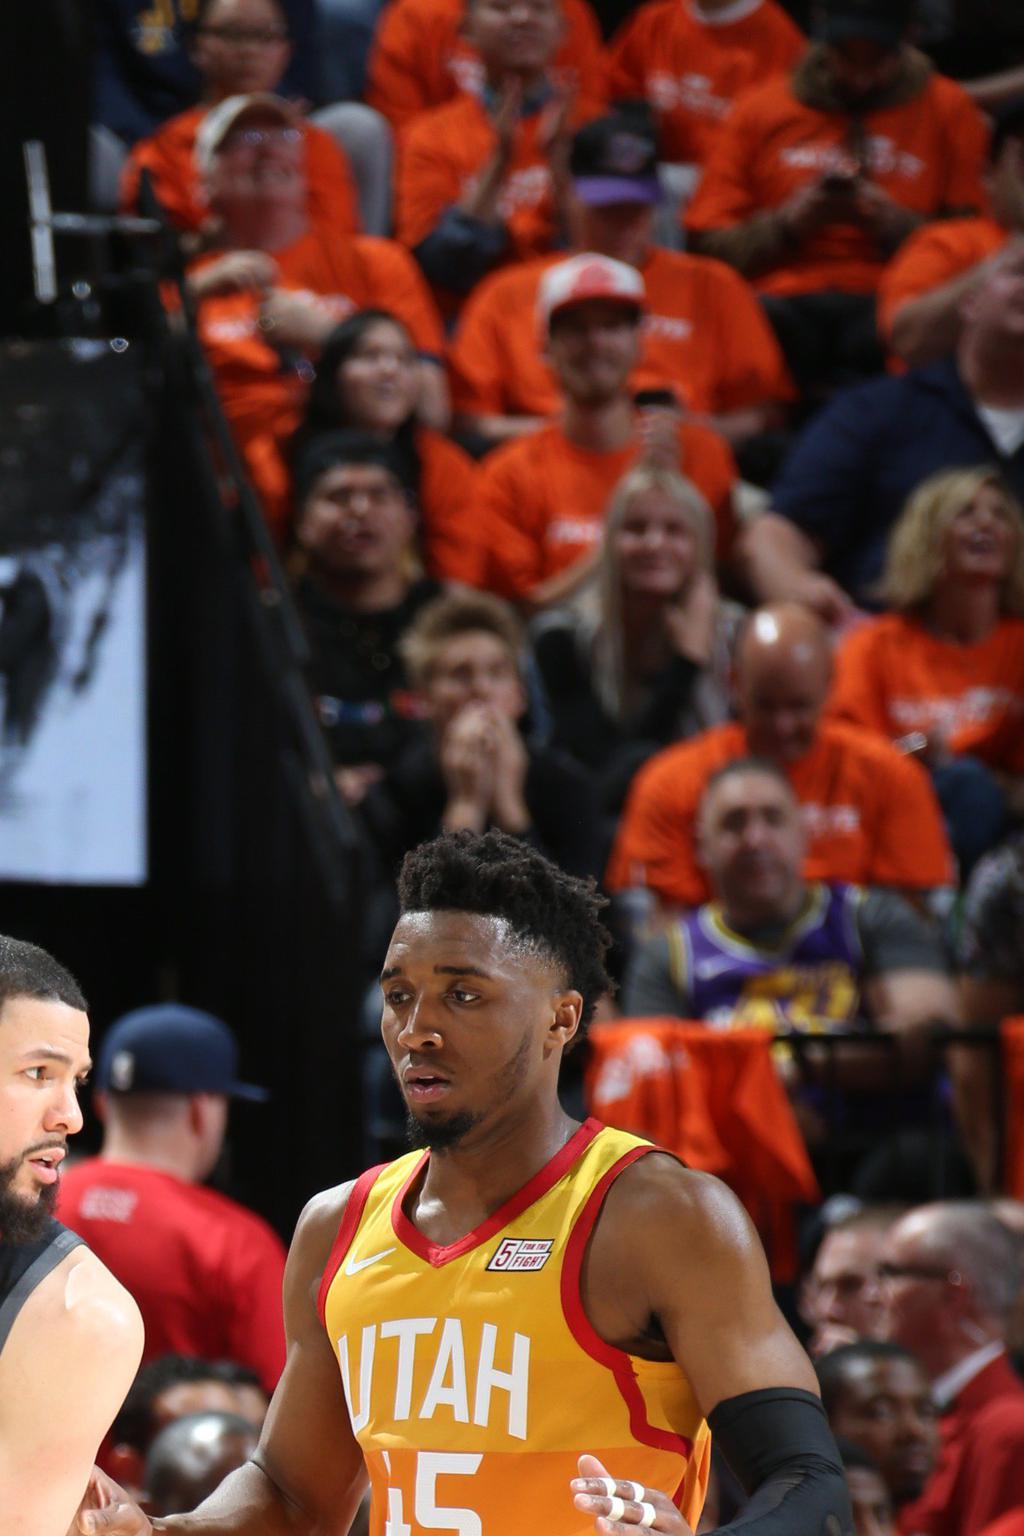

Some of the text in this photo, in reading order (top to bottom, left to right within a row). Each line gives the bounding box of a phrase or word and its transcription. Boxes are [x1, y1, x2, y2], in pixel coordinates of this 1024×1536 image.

[495, 1243, 517, 1267] 5
[512, 1255, 546, 1267] FIGHT
[337, 1317, 530, 1441] UTAH
